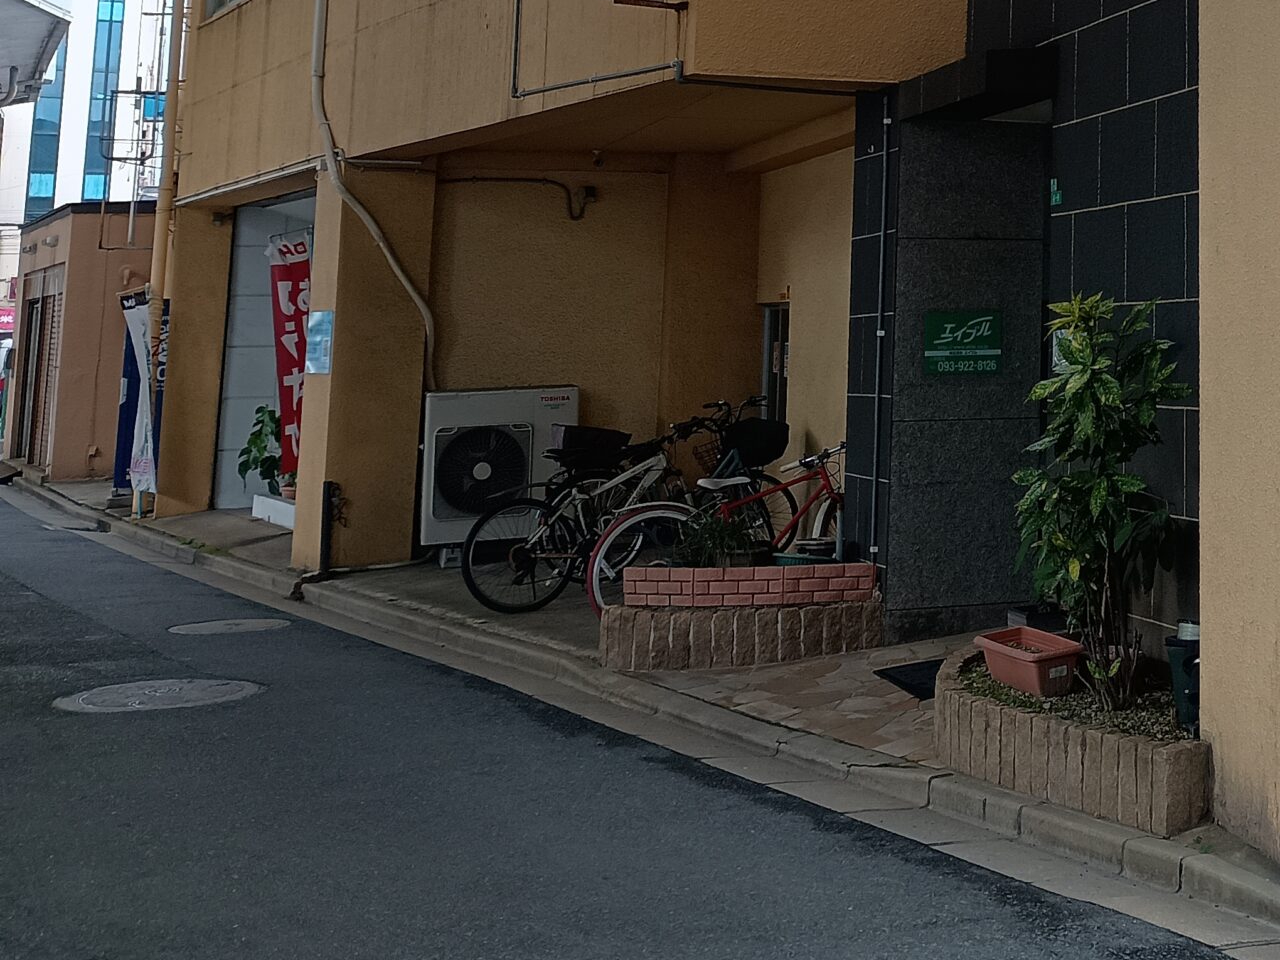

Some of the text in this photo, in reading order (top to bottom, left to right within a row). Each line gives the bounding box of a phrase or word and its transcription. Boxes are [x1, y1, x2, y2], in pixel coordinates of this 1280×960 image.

[934, 316, 993, 344] エイブル
[937, 360, 997, 372] 093-922-8126
